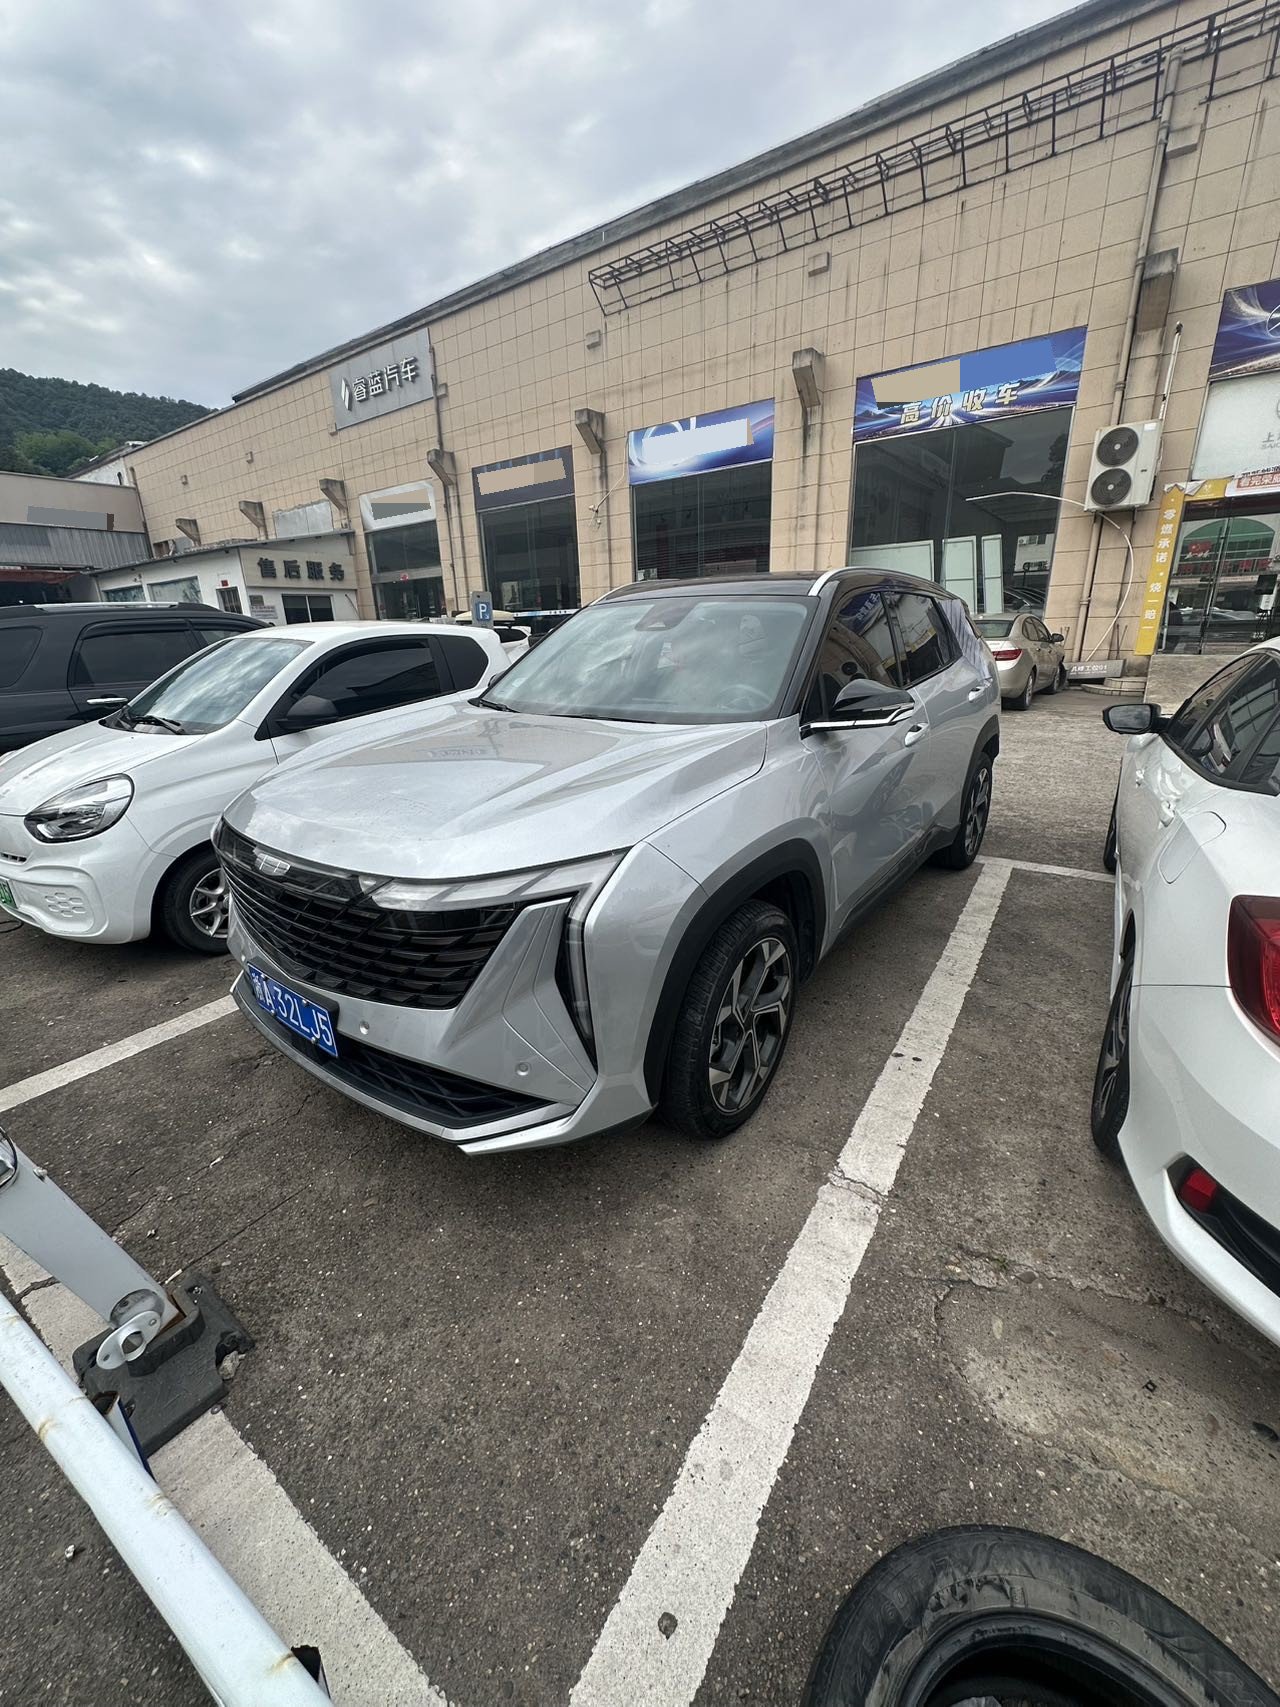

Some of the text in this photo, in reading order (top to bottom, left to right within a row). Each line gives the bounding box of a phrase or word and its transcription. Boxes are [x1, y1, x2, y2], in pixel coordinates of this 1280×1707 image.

[353, 357, 416, 401] 睿蓝汽车
[901, 382, 1021, 424] 高价收车
[257, 557, 345, 581] 售后服务
[480, 603, 488, 619] P
